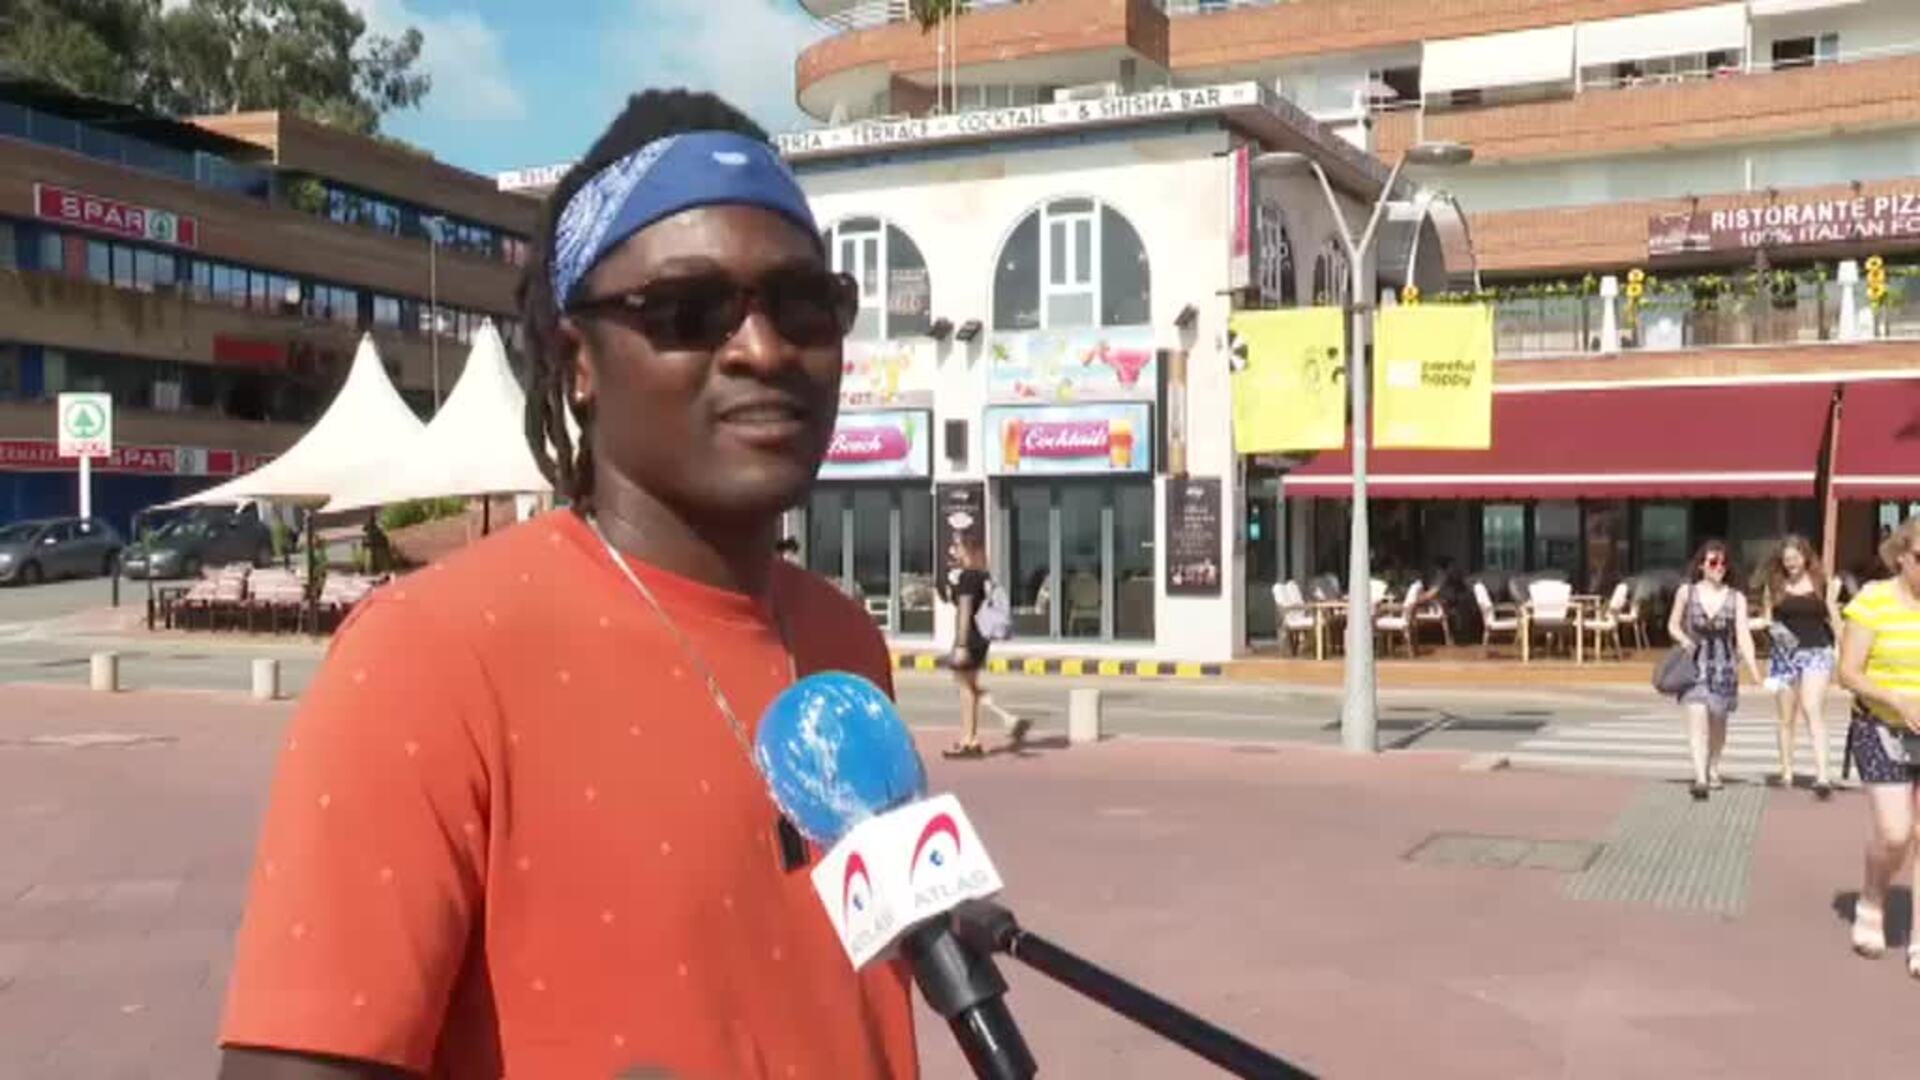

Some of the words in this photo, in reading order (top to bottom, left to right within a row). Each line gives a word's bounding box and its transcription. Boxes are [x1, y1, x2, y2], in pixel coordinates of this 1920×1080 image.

[958, 106, 1047, 133] COCKTAIL
[1099, 96, 1174, 117] SHISHA
[1180, 88, 1220, 108] BAR
[61, 195, 144, 230] SPAR
[1711, 197, 1866, 231] RISTORANTE
[1874, 193, 1920, 218] PIZ
[1740, 229, 1794, 247] 100%
[1799, 218, 1885, 242] ITALIAN
[1421, 373, 1471, 389] happy
[826, 433, 883, 454] Beach
[1024, 427, 1109, 451] Cocktails
[108, 450, 176, 468] SPAR
[914, 869, 988, 909] ATLAS
